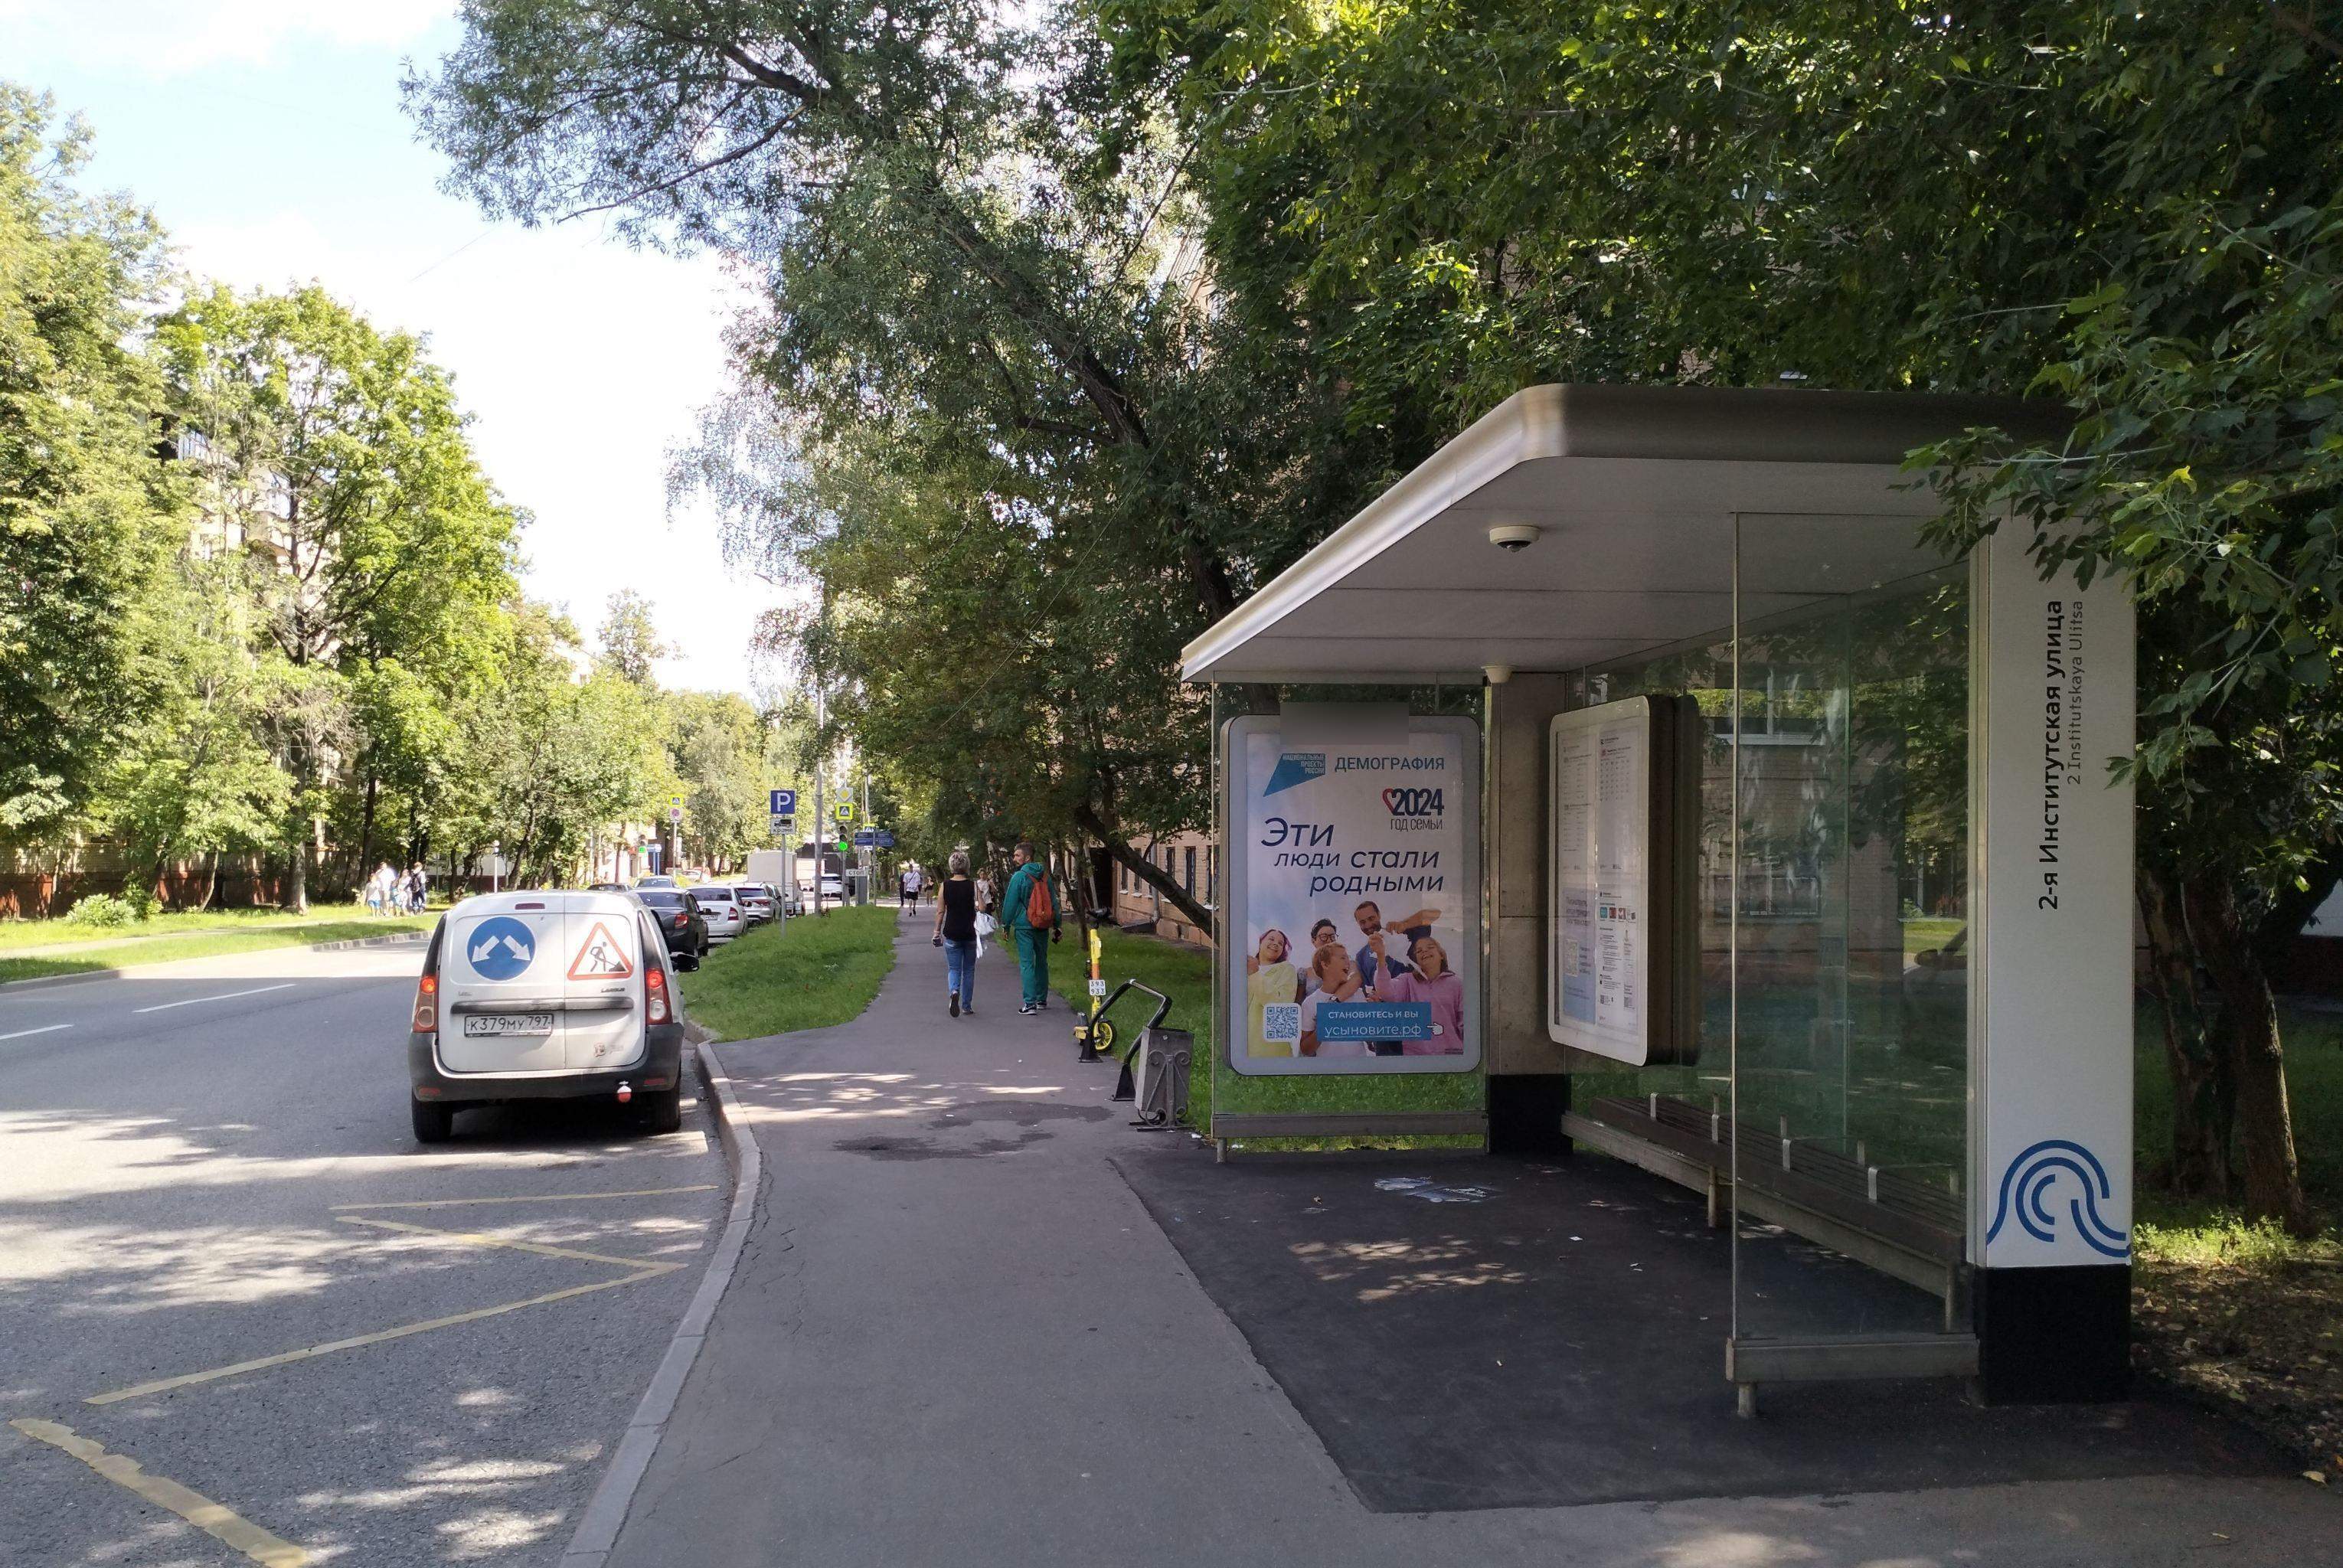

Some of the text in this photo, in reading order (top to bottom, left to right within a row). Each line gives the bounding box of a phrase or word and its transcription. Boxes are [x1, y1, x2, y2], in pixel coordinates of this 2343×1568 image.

[2067, 601, 2086, 785] 2 Institutskaya Ulitsa
[1334, 757, 1445, 773] ДЕМОГРАФИЯ
[2038, 600, 2067, 910] 2-я Институтская улица
[1391, 788, 1445, 816] 2024
[1260, 817, 1335, 847] Эти
[1273, 851, 1439, 870] люди стали
[1309, 875, 1444, 897] родными
[526, 1016, 549, 1027] 797
[1328, 1010, 1394, 1019] СТАНОВИТЕСЬ
[1324, 1024, 1422, 1038] усыновите.рф
